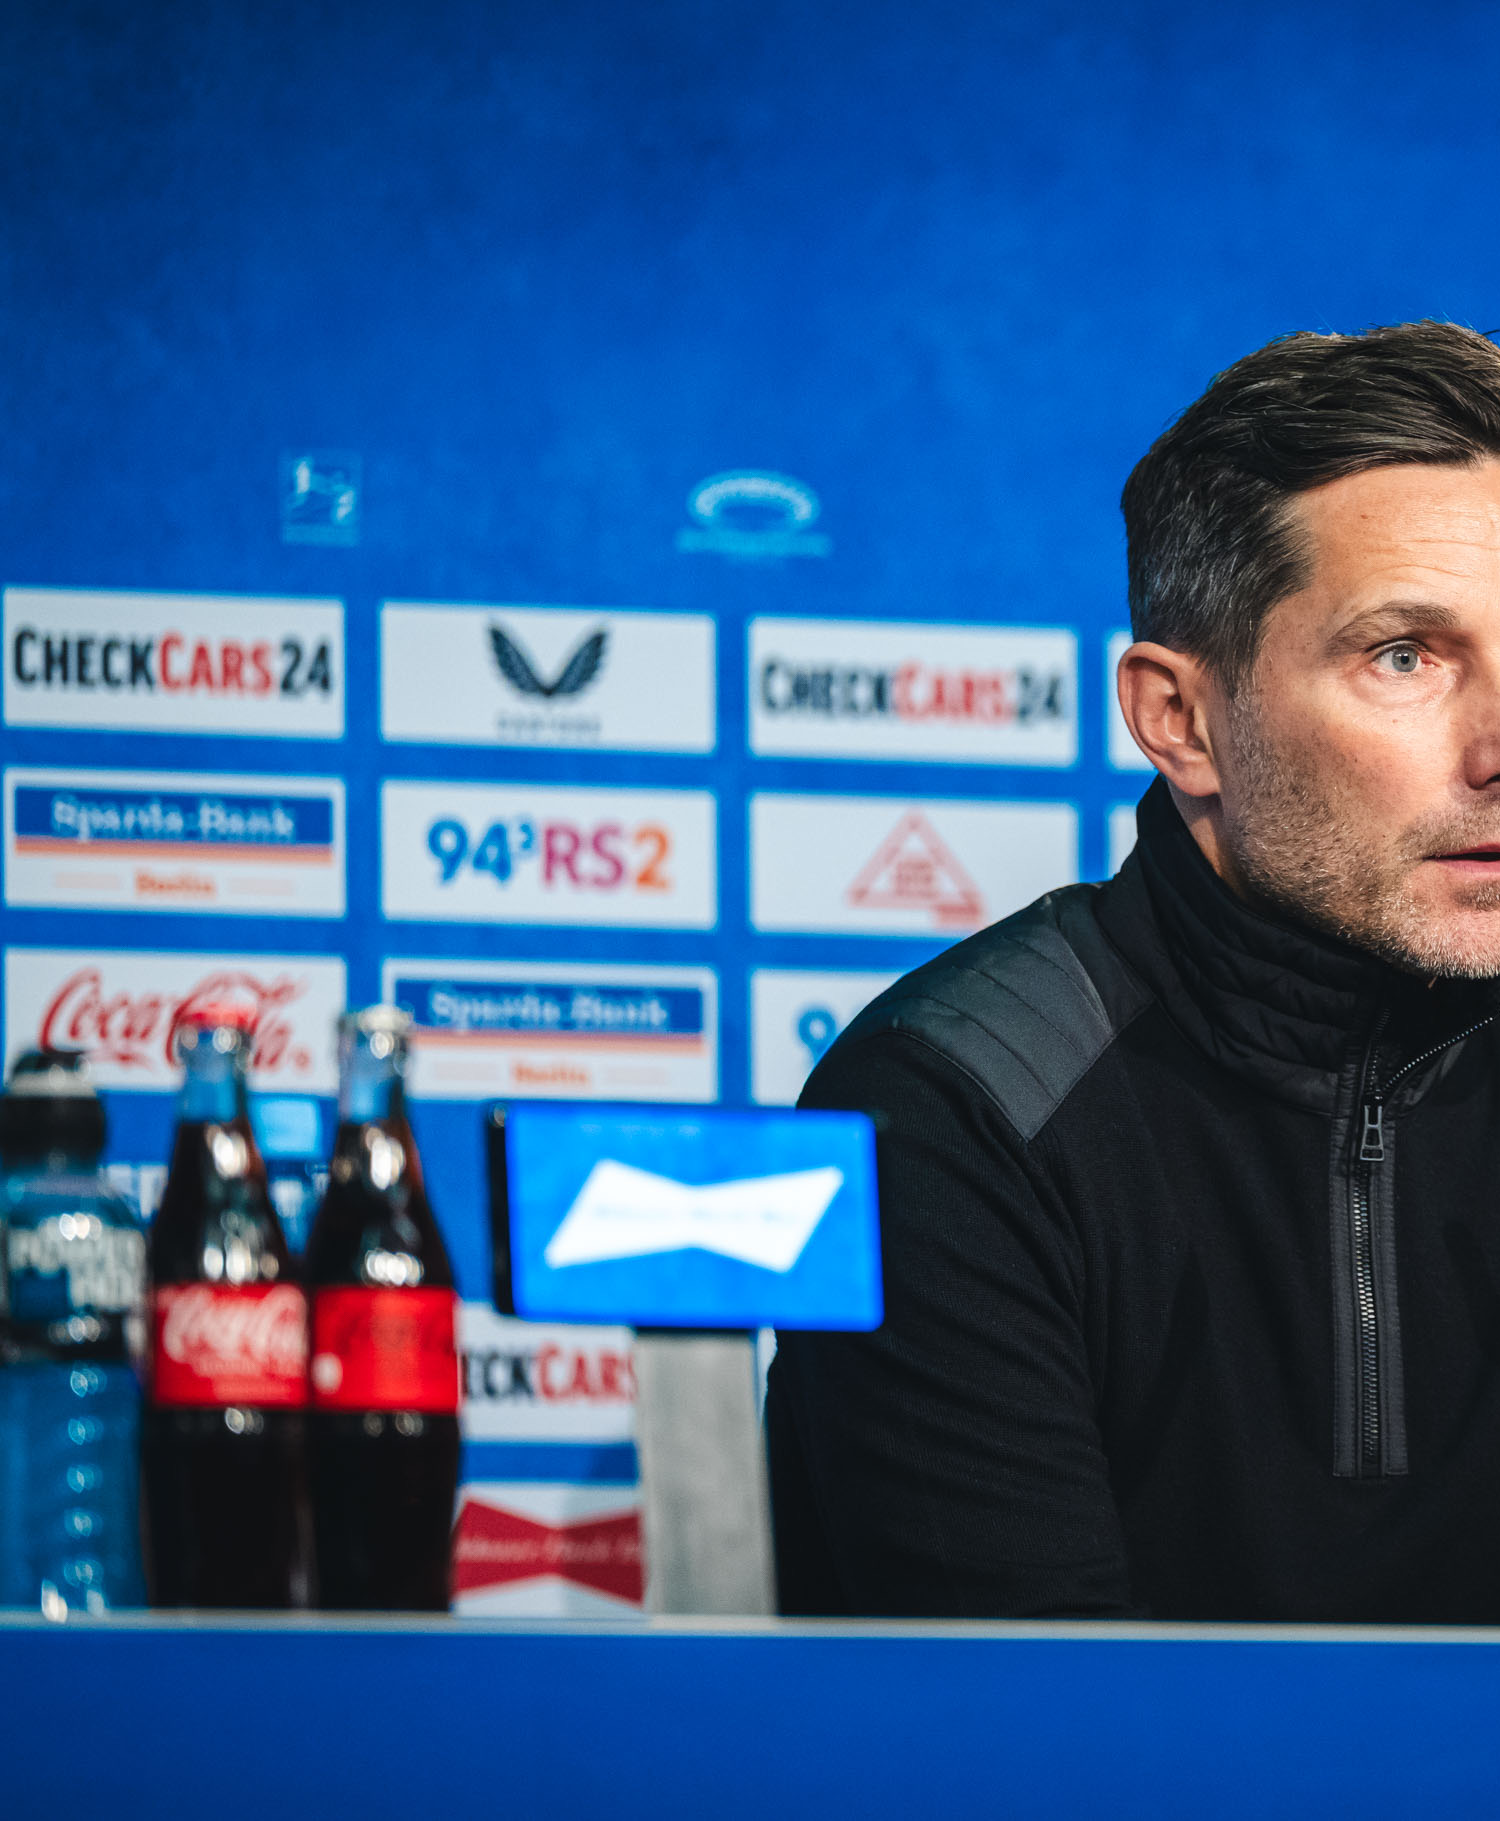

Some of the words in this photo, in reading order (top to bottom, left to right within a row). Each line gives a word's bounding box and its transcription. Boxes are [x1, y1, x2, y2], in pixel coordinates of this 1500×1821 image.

[13, 628, 334, 700] CHECKCARS24
[761, 659, 1068, 728] CHECKCARS24
[38, 965, 306, 1072] Coca-Cla
